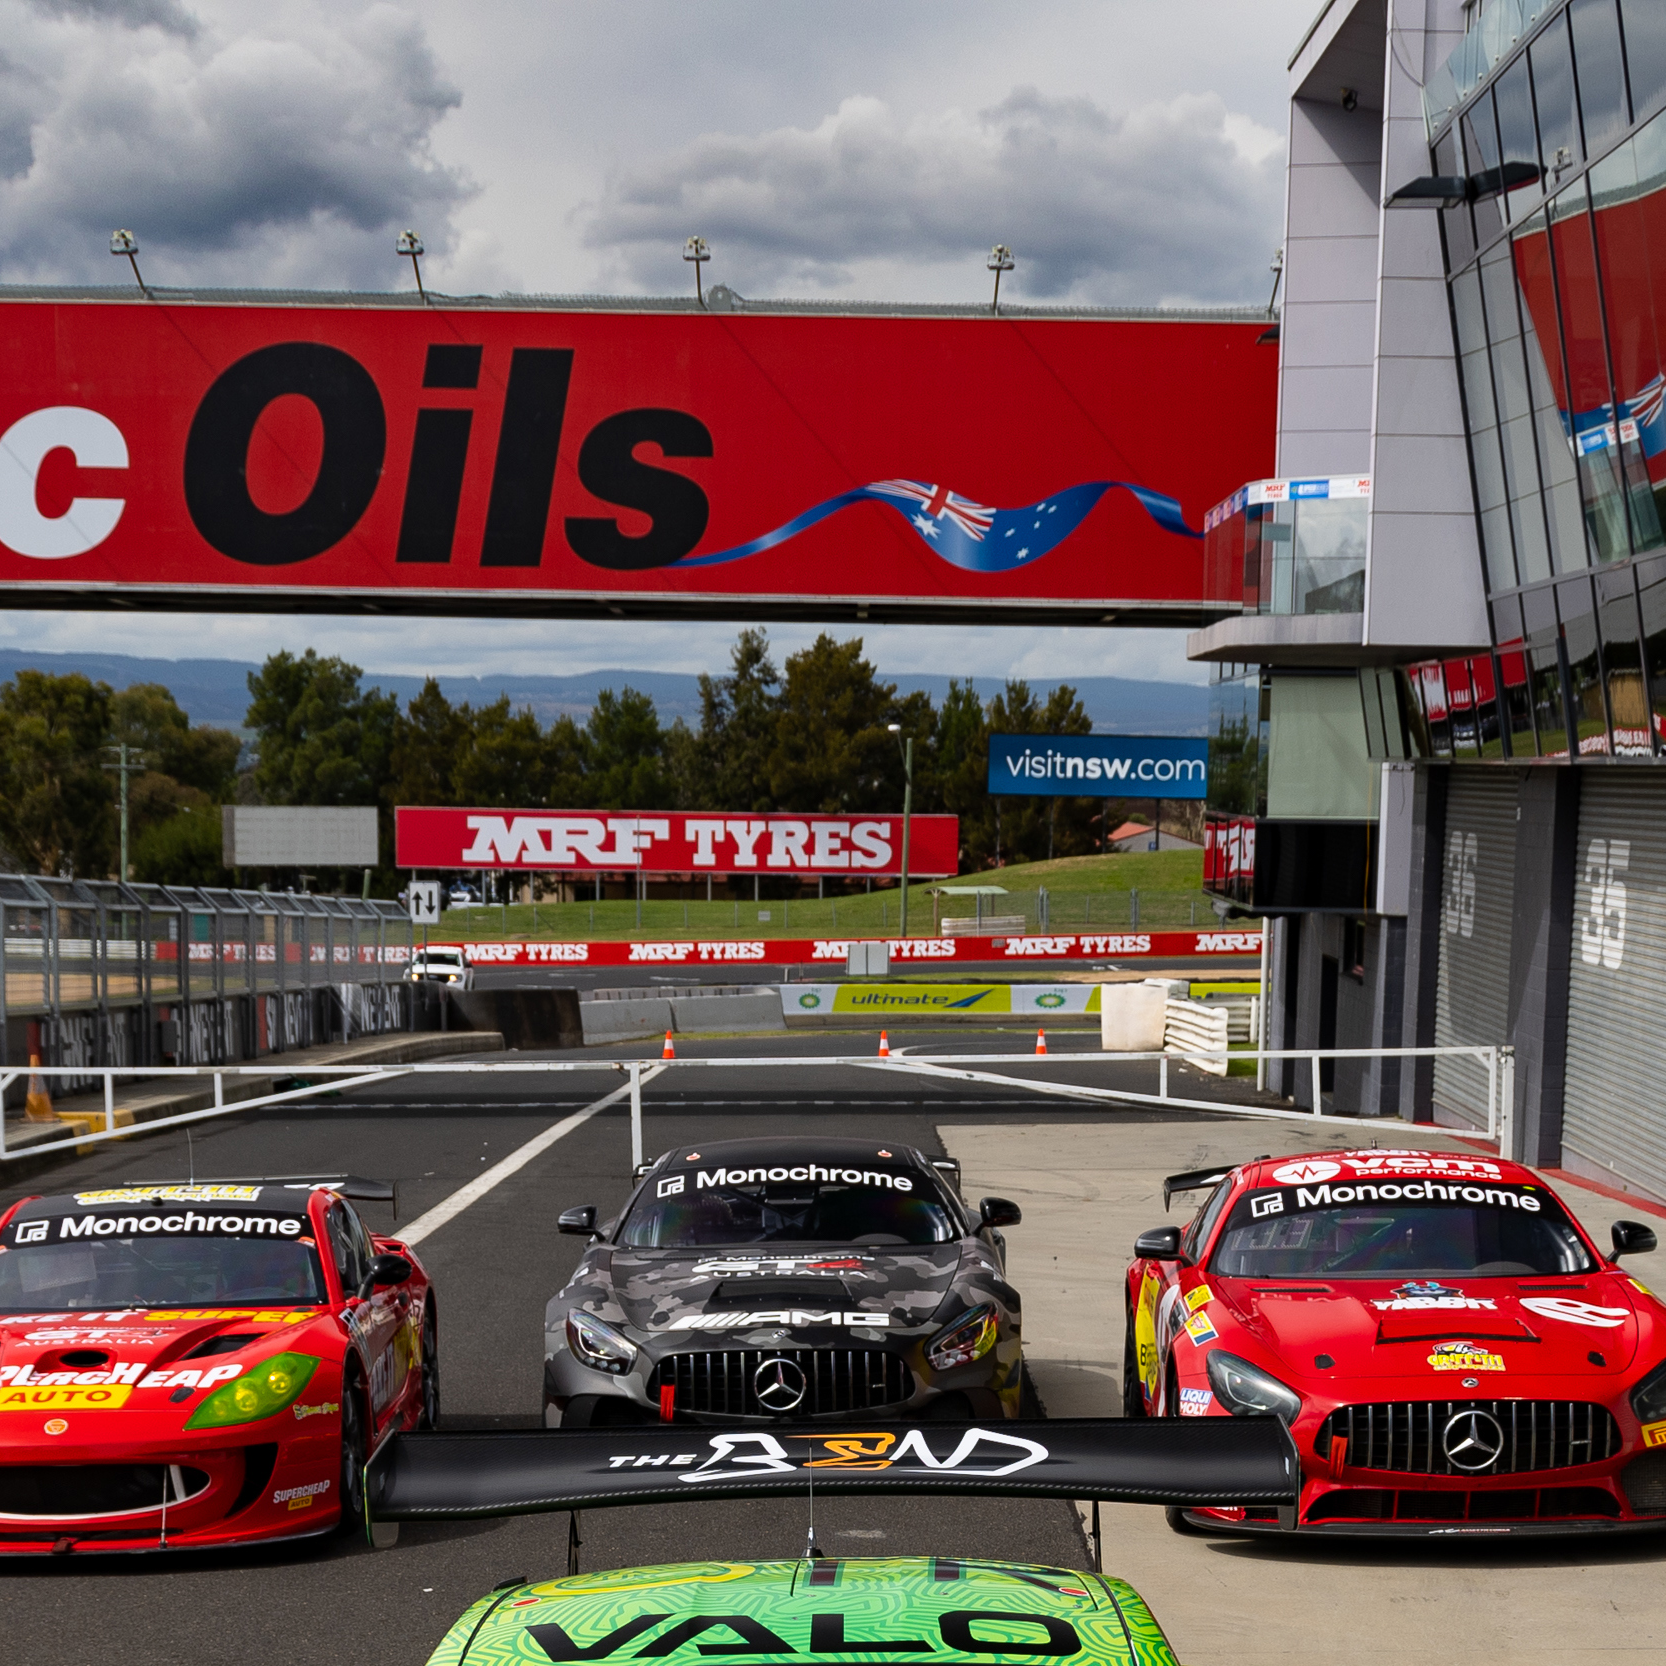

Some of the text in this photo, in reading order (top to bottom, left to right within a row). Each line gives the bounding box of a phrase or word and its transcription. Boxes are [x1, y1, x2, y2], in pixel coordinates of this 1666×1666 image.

[182, 342, 715, 570] Oils
[1005, 748, 1206, 782] visitnsw.com
[462, 815, 893, 869] MRF TYRES
[1446, 831, 1478, 939] 36
[1580, 838, 1631, 970] 35
[464, 942, 589, 962] MRF TYRES
[628, 941, 766, 960] MRF TYRES
[1005, 935, 1152, 955] MRF TYRES
[1195, 933, 1263, 952] MRF
[851, 993, 949, 1008] ultimate
[696, 1163, 914, 1192] Monochrome
[1355, 1167, 1503, 1180] performance
[1297, 1180, 1541, 1212] Monochrome
[59, 1210, 302, 1239] Monochrome
[736, 1311, 890, 1328] AMG
[15, 1337, 154, 1349] AUSTRALIA
[3, 1388, 113, 1405] AUTO
[1181, 1389, 1212, 1404] LIQUI
[1179, 1401, 1209, 1417] MOLY
[609, 1453, 699, 1470] THE
[272, 1479, 331, 1504] SUPERCHEAP
[290, 1497, 311, 1509] AUTO
[526, 1610, 1082, 1664] VALO
